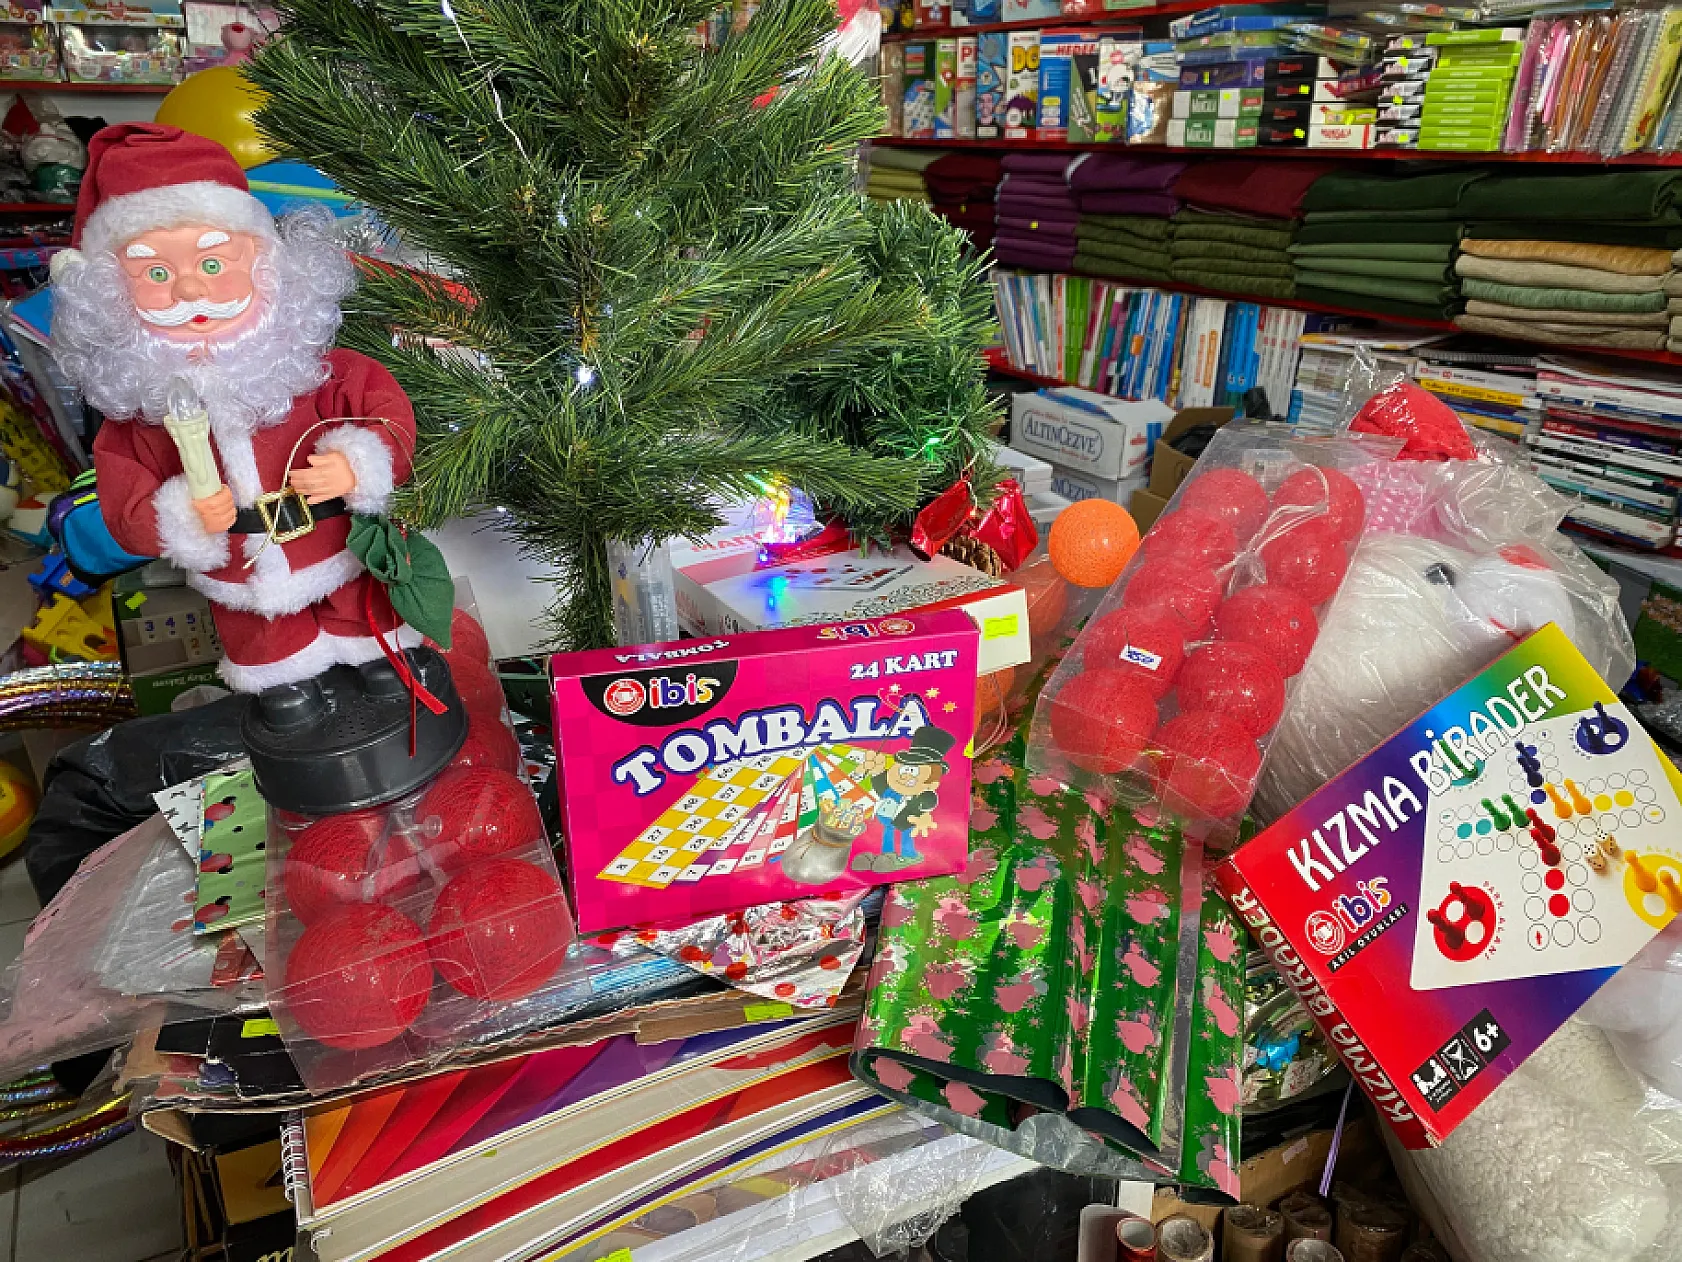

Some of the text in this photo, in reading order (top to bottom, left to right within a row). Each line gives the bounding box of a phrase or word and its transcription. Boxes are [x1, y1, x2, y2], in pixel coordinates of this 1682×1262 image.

[650, 672, 721, 709] ibis
[850, 650, 958, 680] 24 KART
[612, 695, 931, 797] TOMBALA
[1286, 665, 1568, 892] KIZMA BİRADER
[1332, 876, 1392, 933] ibis
[1473, 1022, 1499, 1052] 6+
[1329, 1022, 1415, 1123] KIZMA
